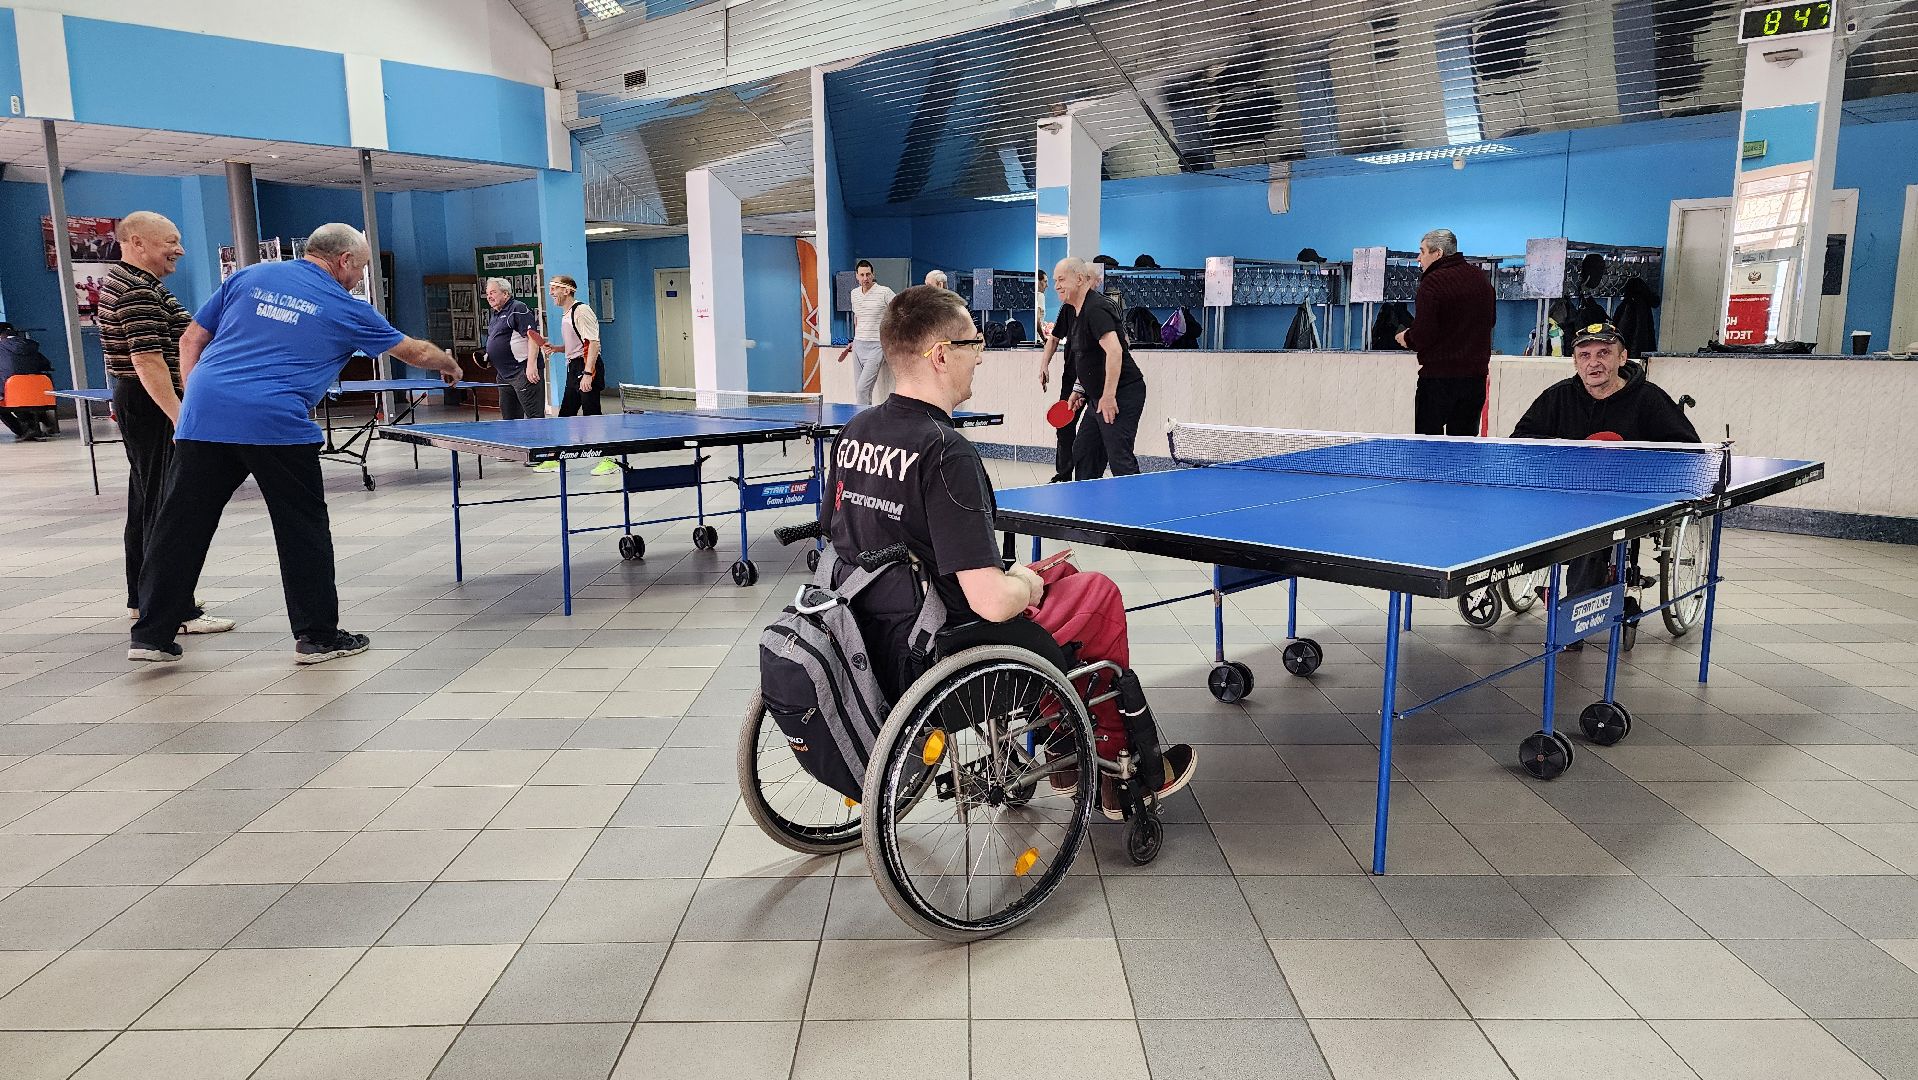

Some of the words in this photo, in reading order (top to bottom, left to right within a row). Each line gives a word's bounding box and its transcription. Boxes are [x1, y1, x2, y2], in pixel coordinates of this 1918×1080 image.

[256, 302, 300, 325] БАЛАШИХА
[559, 450, 580, 460] Game
[580, 448, 603, 458] indoor
[837, 438, 920, 482] GORSKY
[763, 485, 790, 495] START
[791, 483, 808, 493] LINE
[766, 496, 784, 506] Game
[784, 494, 805, 504] indoor
[1573, 600, 1597, 618] START
